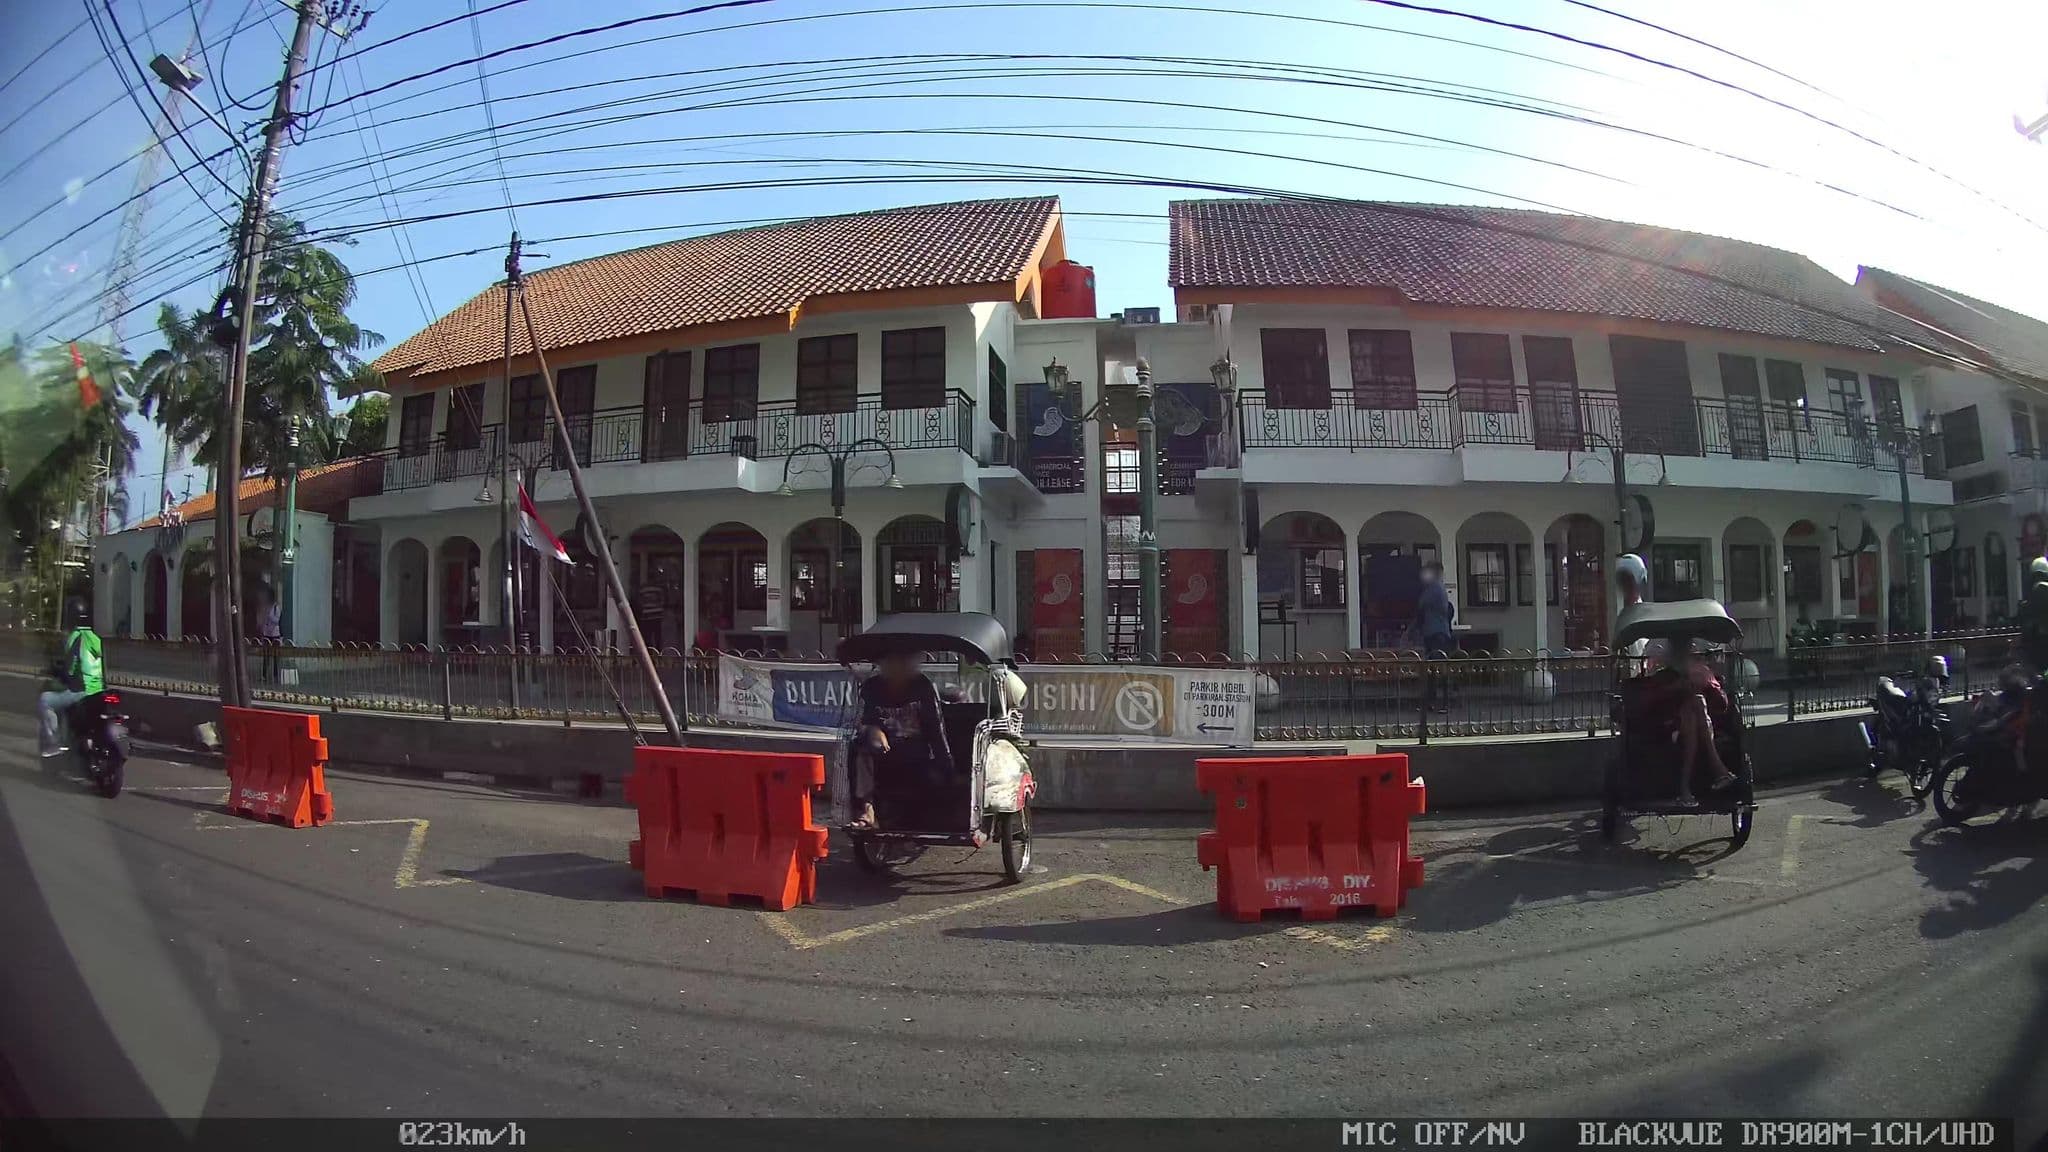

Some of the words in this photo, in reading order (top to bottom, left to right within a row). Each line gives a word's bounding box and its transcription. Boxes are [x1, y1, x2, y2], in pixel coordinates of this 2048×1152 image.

[1190, 681, 1219, 693] PARKIR
[1221, 682, 1246, 694] MOBIL
[1192, 693, 1223, 702] PARKIRAN
[1329, 892, 1361, 905] 2016
